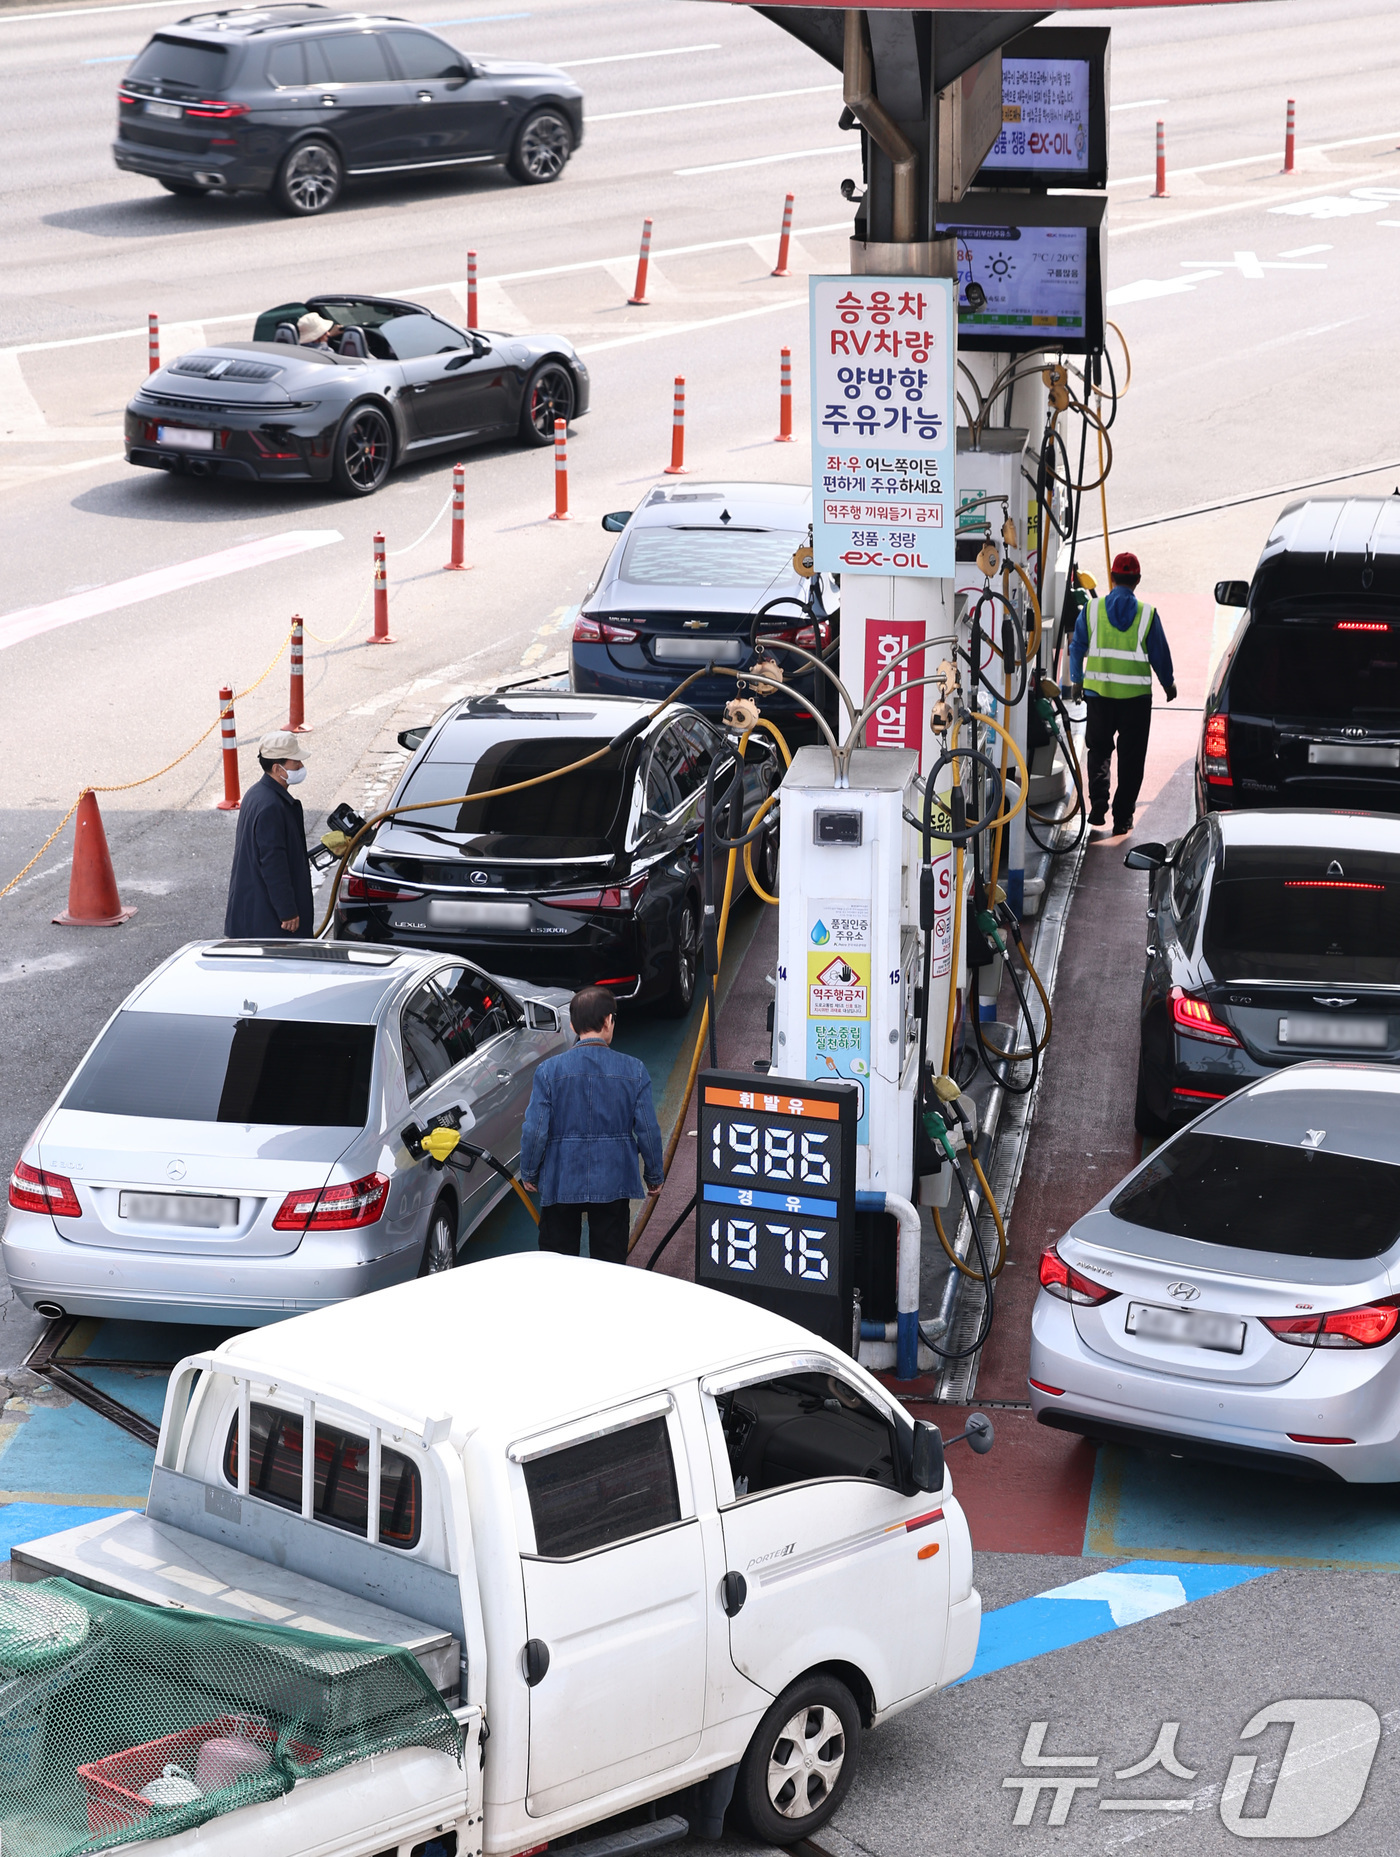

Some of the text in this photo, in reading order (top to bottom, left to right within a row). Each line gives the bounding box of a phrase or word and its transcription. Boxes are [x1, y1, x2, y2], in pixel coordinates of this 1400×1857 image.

[836, 291, 927, 324] 승용차
[831, 329, 934, 363] RV차량
[837, 367, 927, 401] 양방향
[822, 405, 942, 440] 주유가능
[866, 457, 938, 476] 어느쪽이든
[823, 476, 942, 494] 편하게 주유하세요
[827, 504, 938, 522] 역주행 끼워들기 금지
[876, 634, 909, 748] 화기엄
[831, 919, 868, 931] 품질인증
[836, 931, 864, 941] 주유소
[778, 966, 787, 981] 14
[890, 970, 900, 985] 15
[813, 989, 864, 1001] 역주행금지
[816, 1026, 860, 1039] 탄소중립
[816, 1039, 860, 1050] 실천하기
[712, 1122, 831, 1184] 1986
[711, 1218, 828, 1280] 1876
[1076, 1261, 1114, 1277] AVANTE
